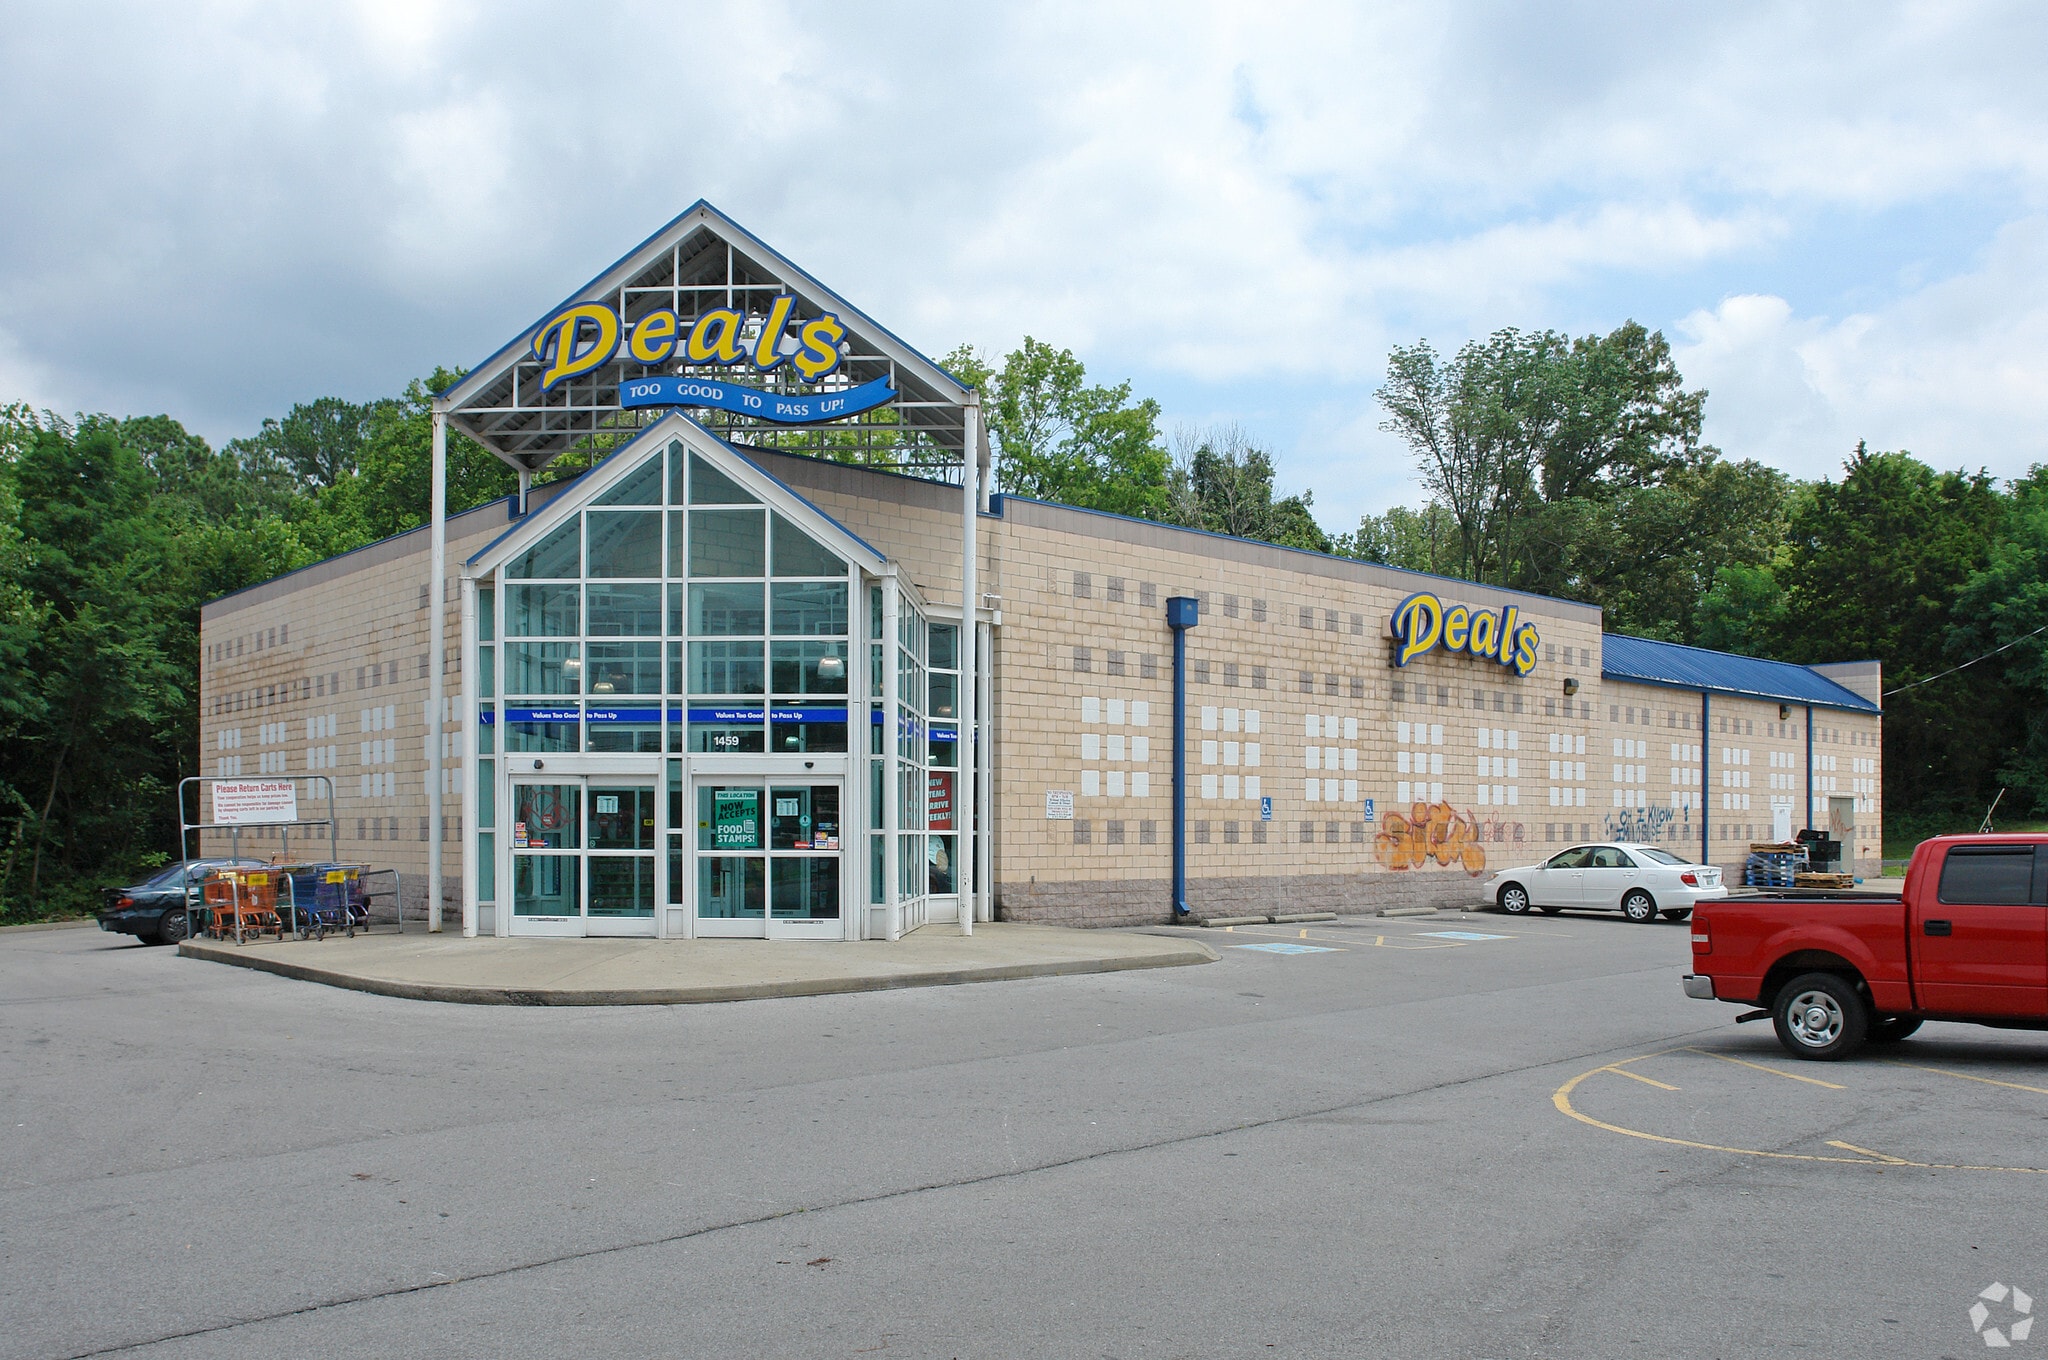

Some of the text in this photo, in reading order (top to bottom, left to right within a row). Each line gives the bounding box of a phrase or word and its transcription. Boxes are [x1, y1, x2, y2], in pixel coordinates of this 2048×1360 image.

[630, 383, 845, 416] TOO GOOD TO PASS UP!
[608, 712, 617, 720] Up
[794, 712, 803, 720] Up
[714, 736, 739, 746] 1459
[216, 783, 292, 793] Please Return Carts Here
[929, 789, 946, 798] TEMS
[720, 801, 744, 812] NOW
[718, 807, 756, 821] ACCEPTS
[717, 825, 743, 834] FOOD
[717, 834, 755, 843] STAMPS!
